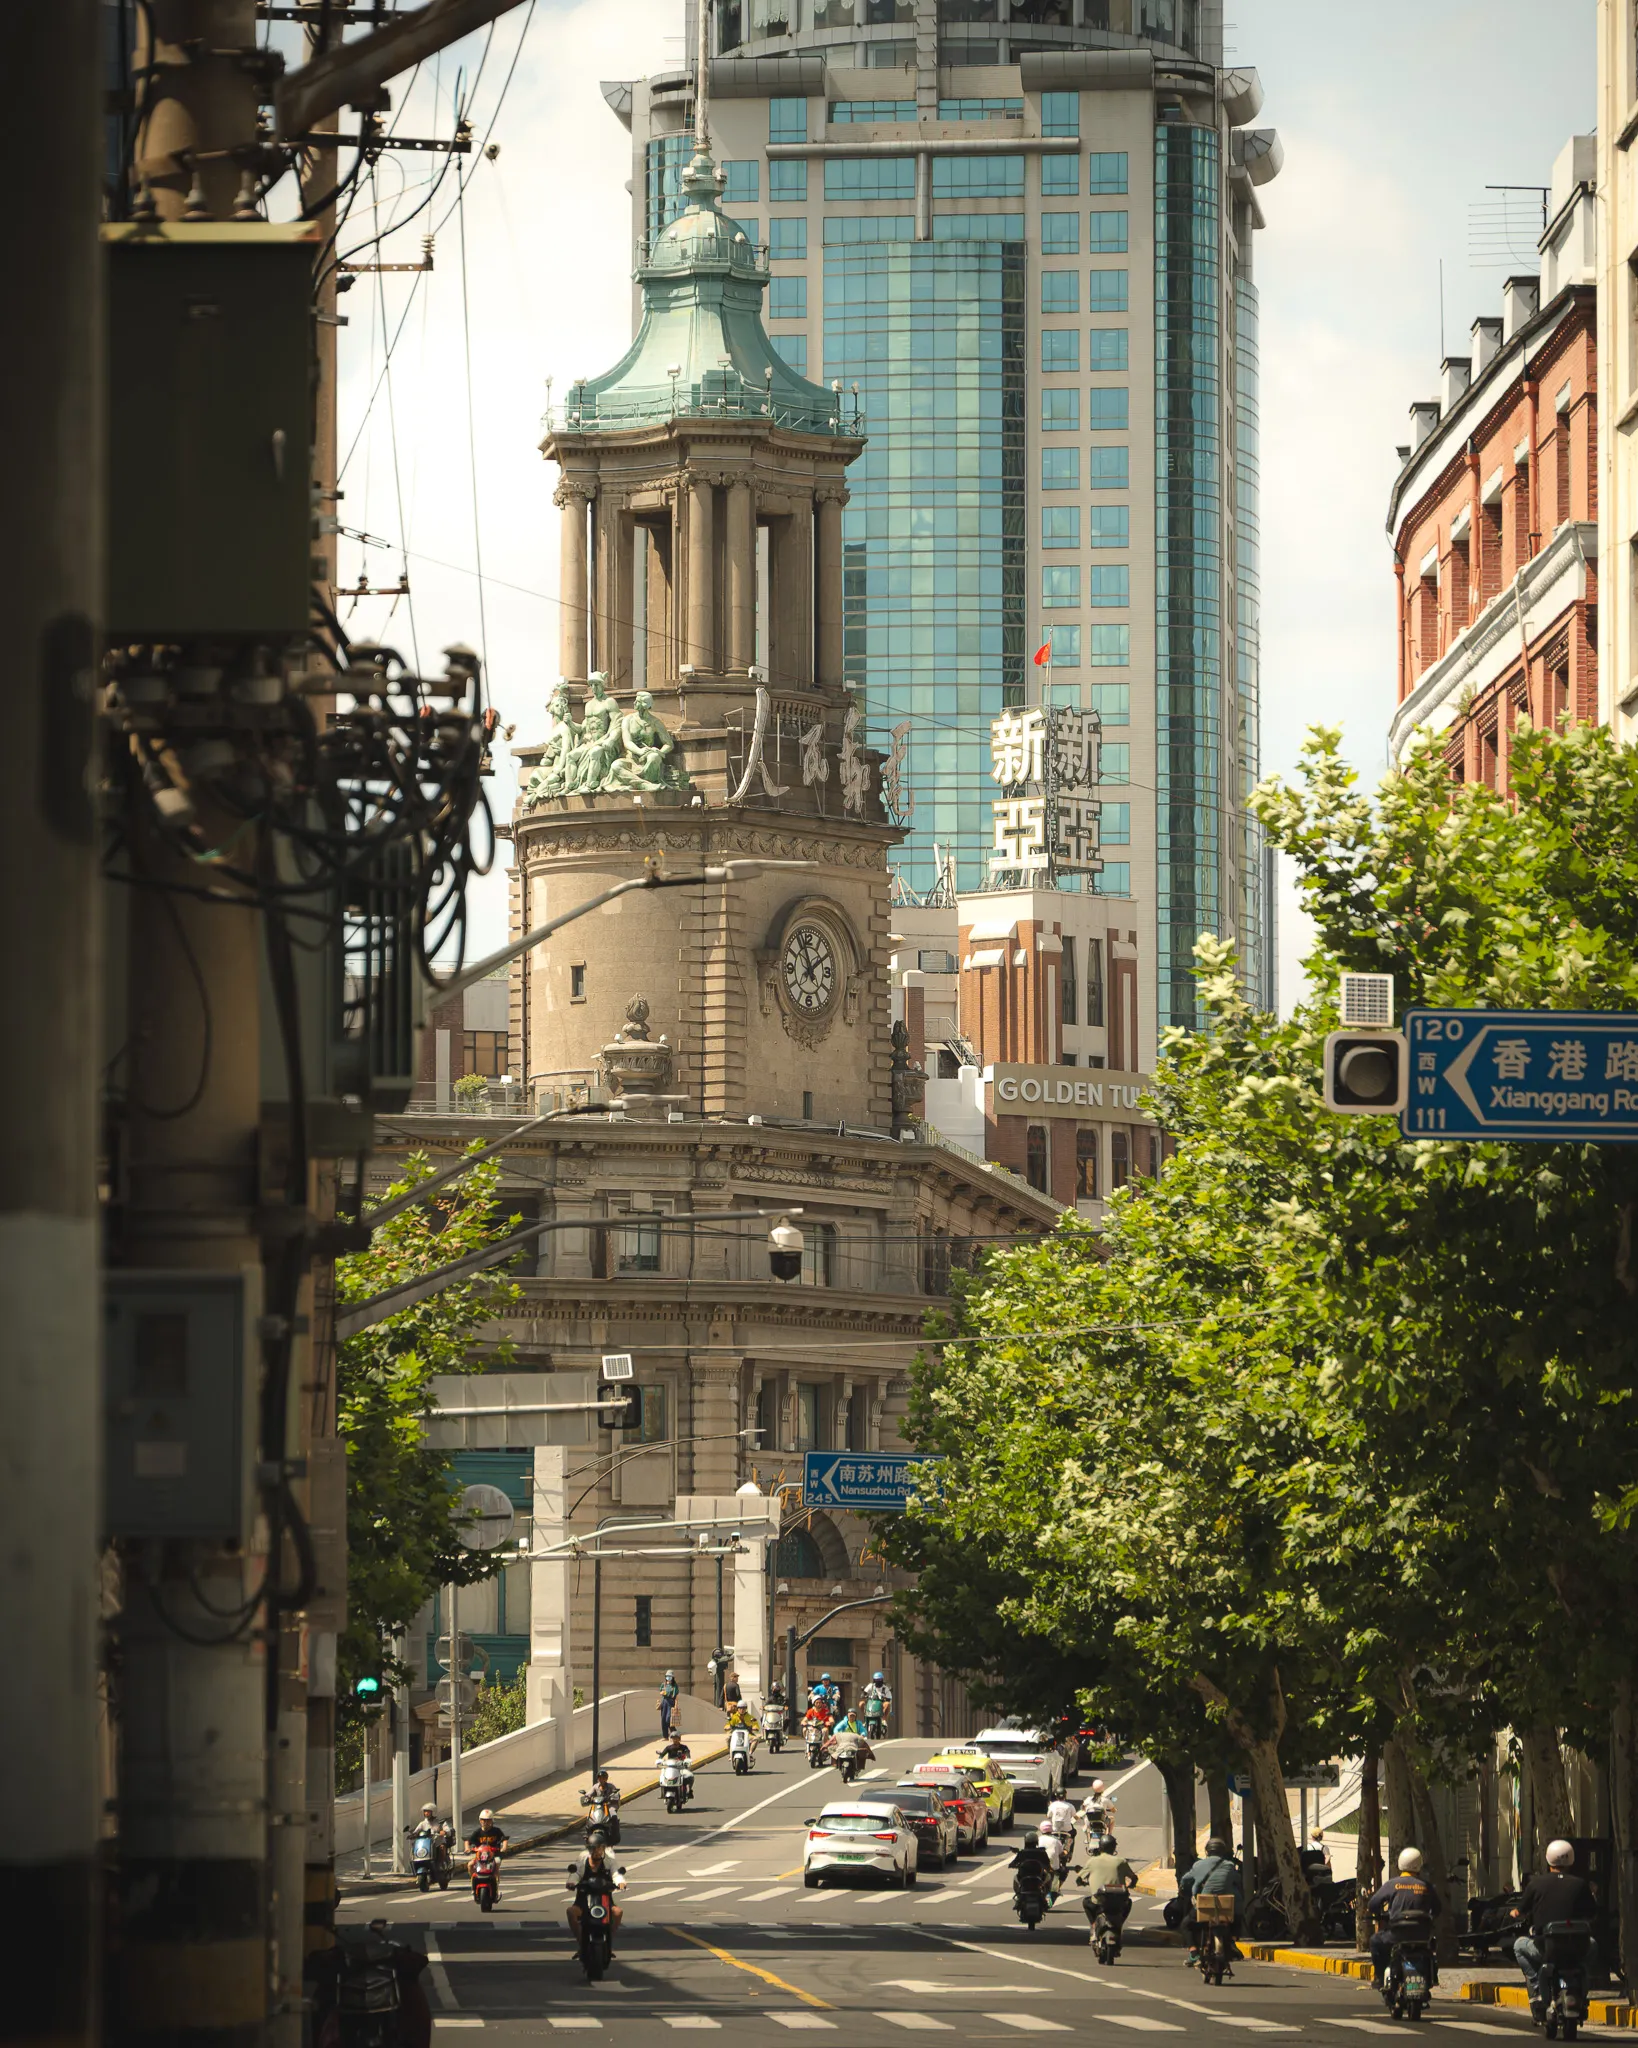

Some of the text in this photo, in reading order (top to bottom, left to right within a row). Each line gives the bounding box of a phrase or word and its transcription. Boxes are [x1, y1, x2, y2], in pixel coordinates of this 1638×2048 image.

[989, 705, 1049, 871] 新亞
[1053, 704, 1104, 875] 新亞
[805, 933, 813, 946] 12
[787, 962, 795, 974] 9
[824, 967, 831, 978] 3
[805, 996, 812, 1007] 6
[1415, 1019, 1464, 1041] 120
[1418, 1053, 1437, 1071] 西
[1492, 1039, 1638, 1082] 香港路
[998, 1077, 1103, 1107] GOLDEN
[1418, 1076, 1436, 1095] W
[1490, 1085, 1609, 1117] Xianggang
[1416, 1107, 1446, 1129] 111
[840, 1464, 912, 1485] 南苏州路
[810, 1480, 819, 1489] W
[840, 1484, 911, 1497] Nansuzhou Rd
[806, 1493, 833, 1504] 245
